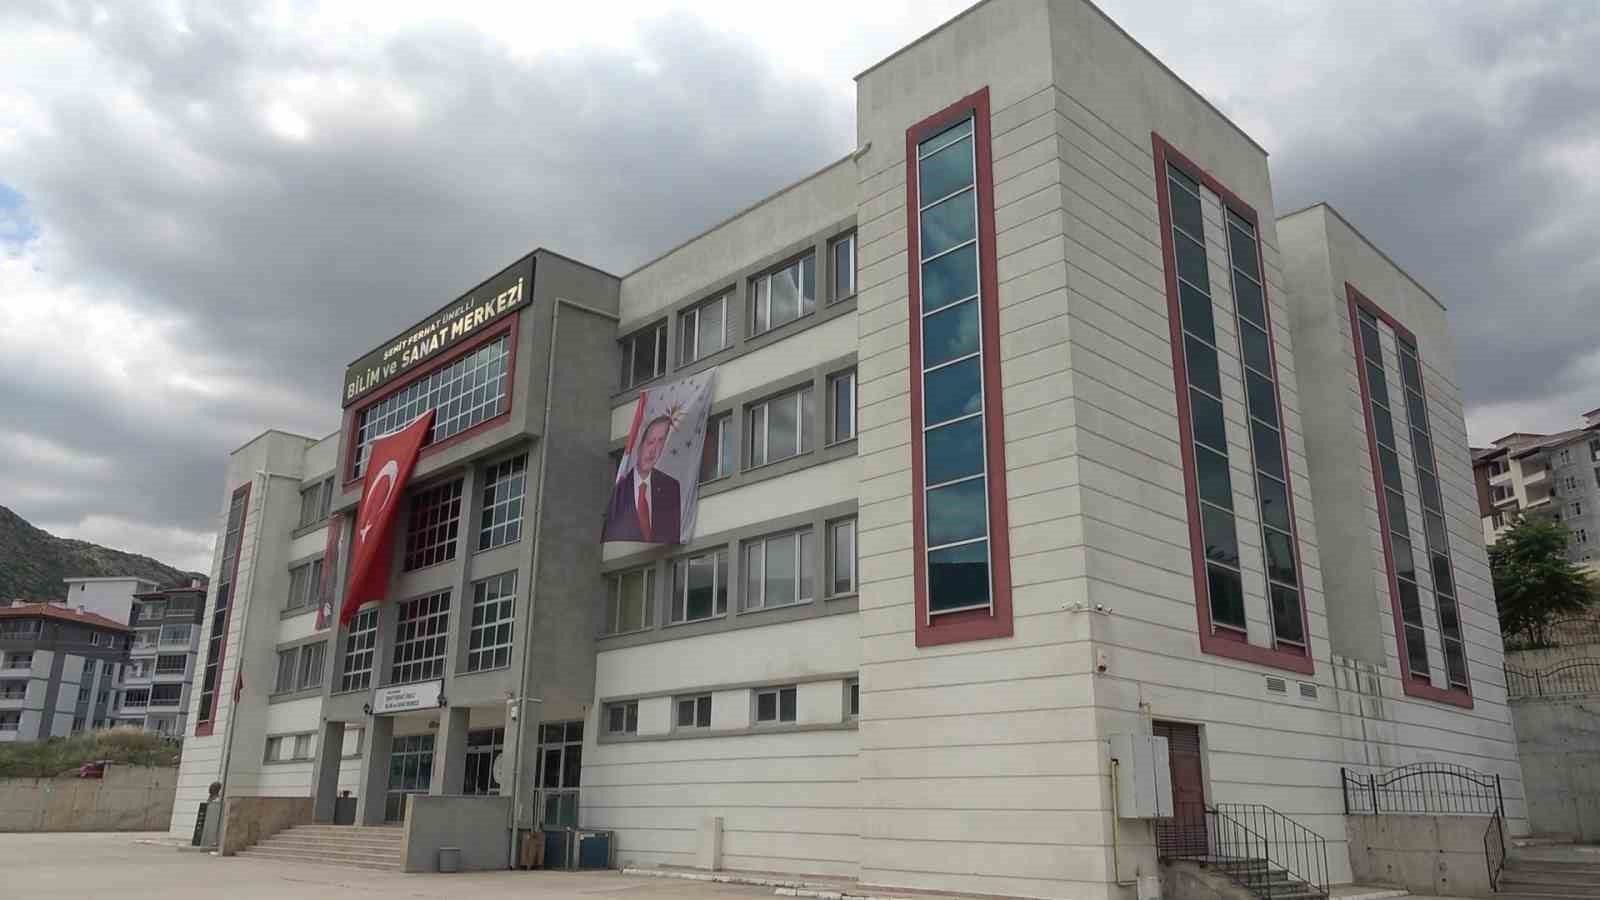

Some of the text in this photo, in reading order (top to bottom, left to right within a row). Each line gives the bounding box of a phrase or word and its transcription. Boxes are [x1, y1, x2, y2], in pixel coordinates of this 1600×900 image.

[347, 277, 524, 399] BİLİM ve SANAT MERKEZİ
[408, 321, 441, 346] FERHAT
